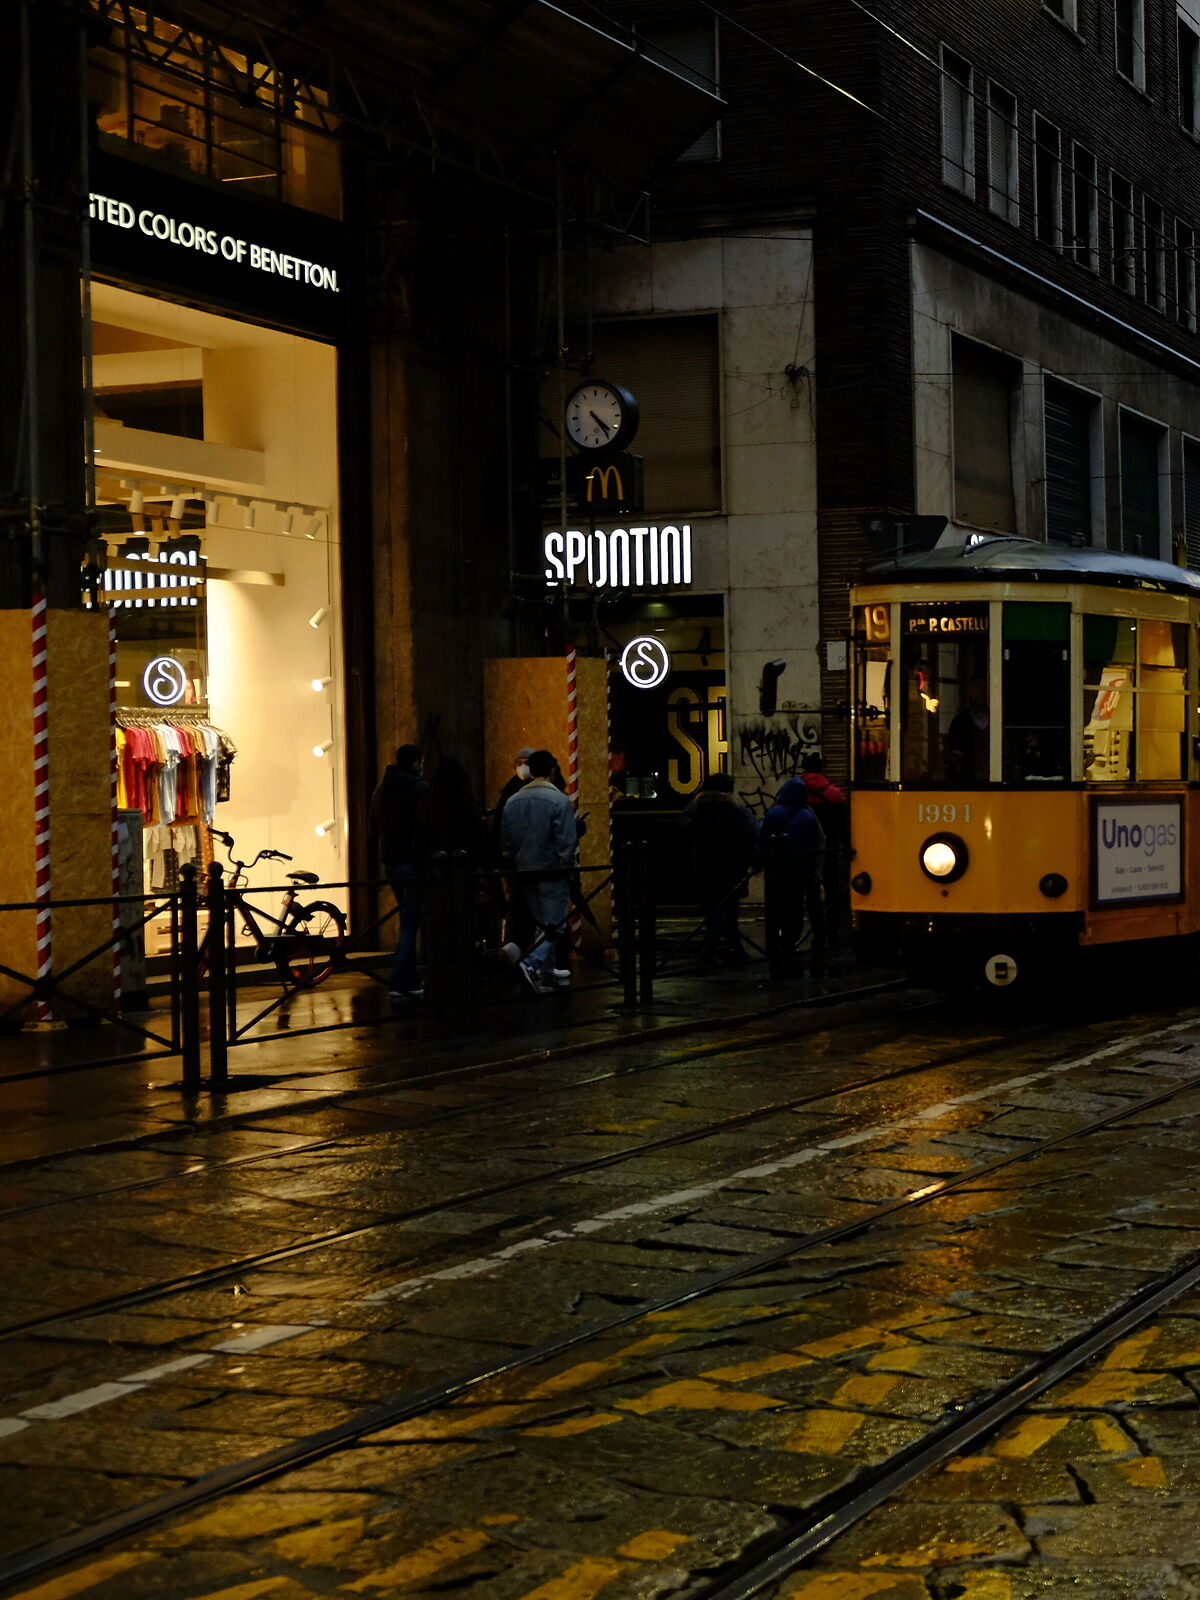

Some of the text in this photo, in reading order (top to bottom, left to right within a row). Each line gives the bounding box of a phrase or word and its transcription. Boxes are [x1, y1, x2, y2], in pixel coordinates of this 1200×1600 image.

[138, 209, 219, 255] COLORS
[220, 235, 247, 263] OF
[544, 524, 693, 588] SPONTINI
[864, 606, 890, 641] 19
[917, 803, 973, 823] 1991
[1102, 818, 1177, 857] Unogas
